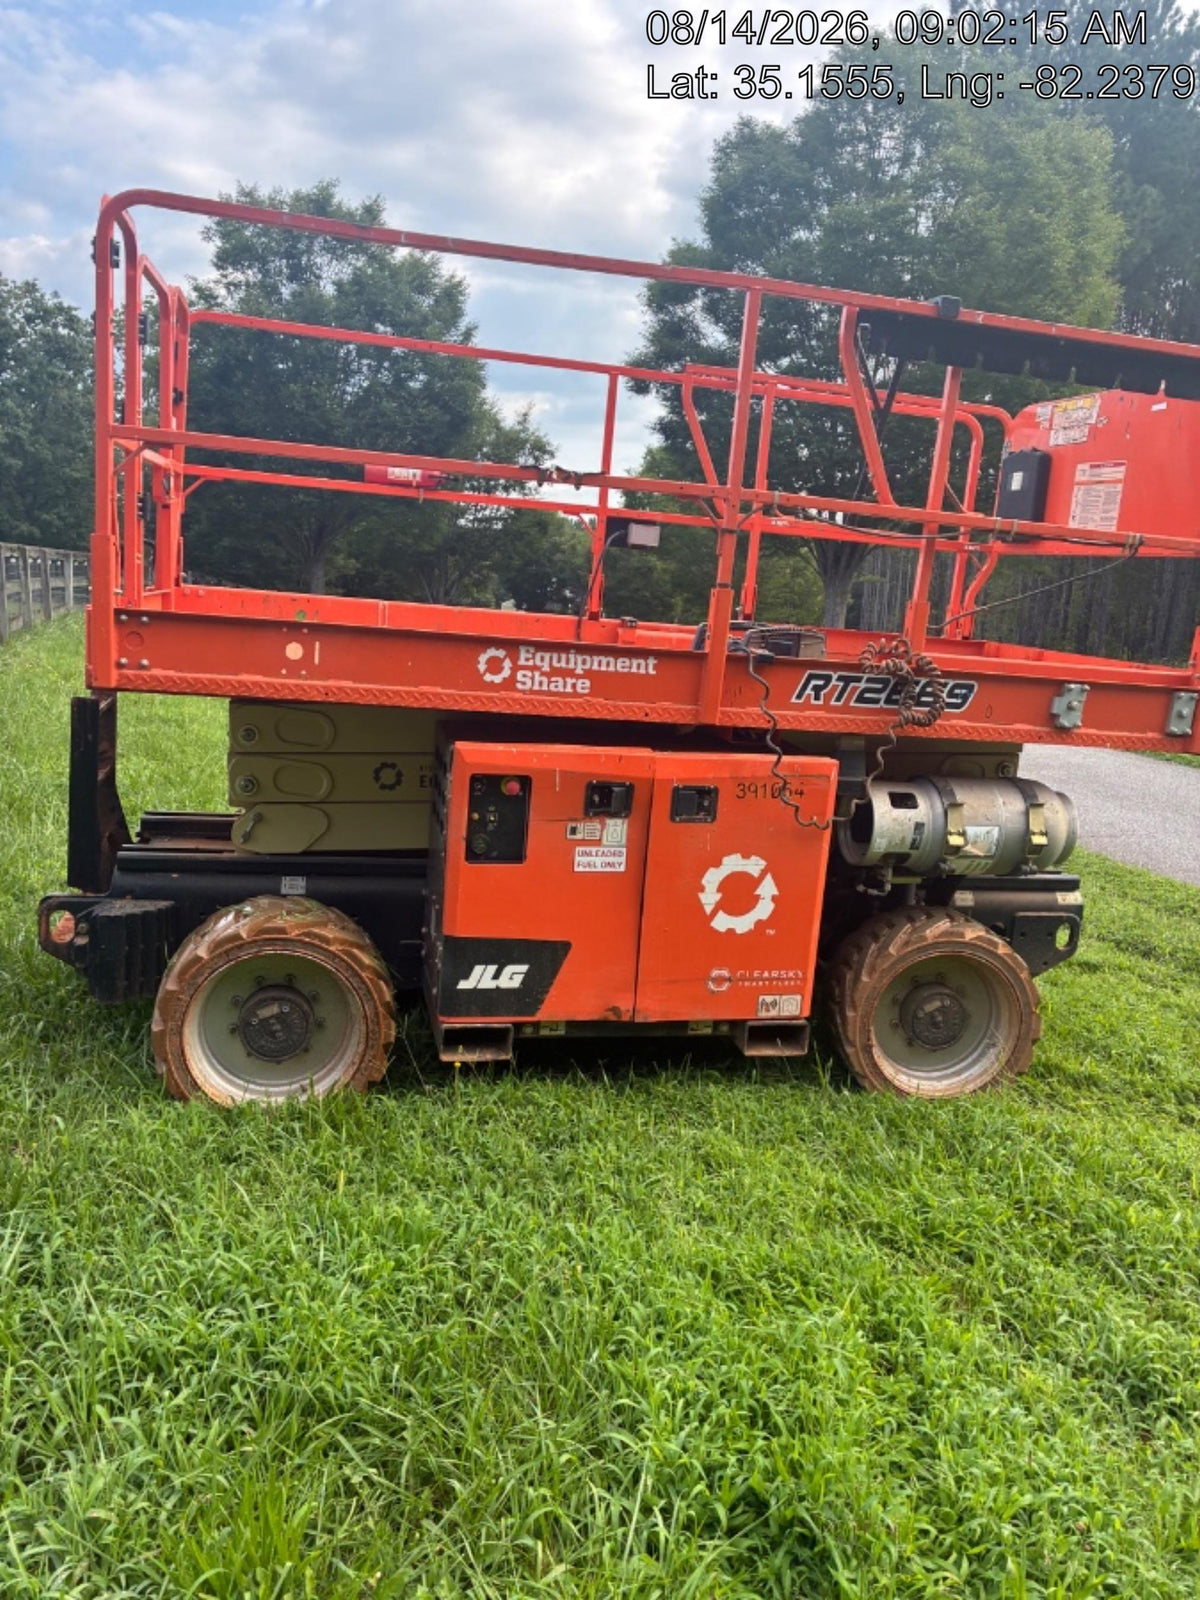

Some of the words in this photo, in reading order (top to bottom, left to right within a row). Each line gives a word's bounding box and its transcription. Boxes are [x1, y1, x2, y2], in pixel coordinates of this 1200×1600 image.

[517, 645, 658, 675] Equipment
[516, 670, 591, 694] Share
[577, 849, 625, 858] UNLEADED
[577, 860, 598, 869] FUEL
[600, 861, 623, 869] ONLY
[456, 964, 530, 989] JLG
